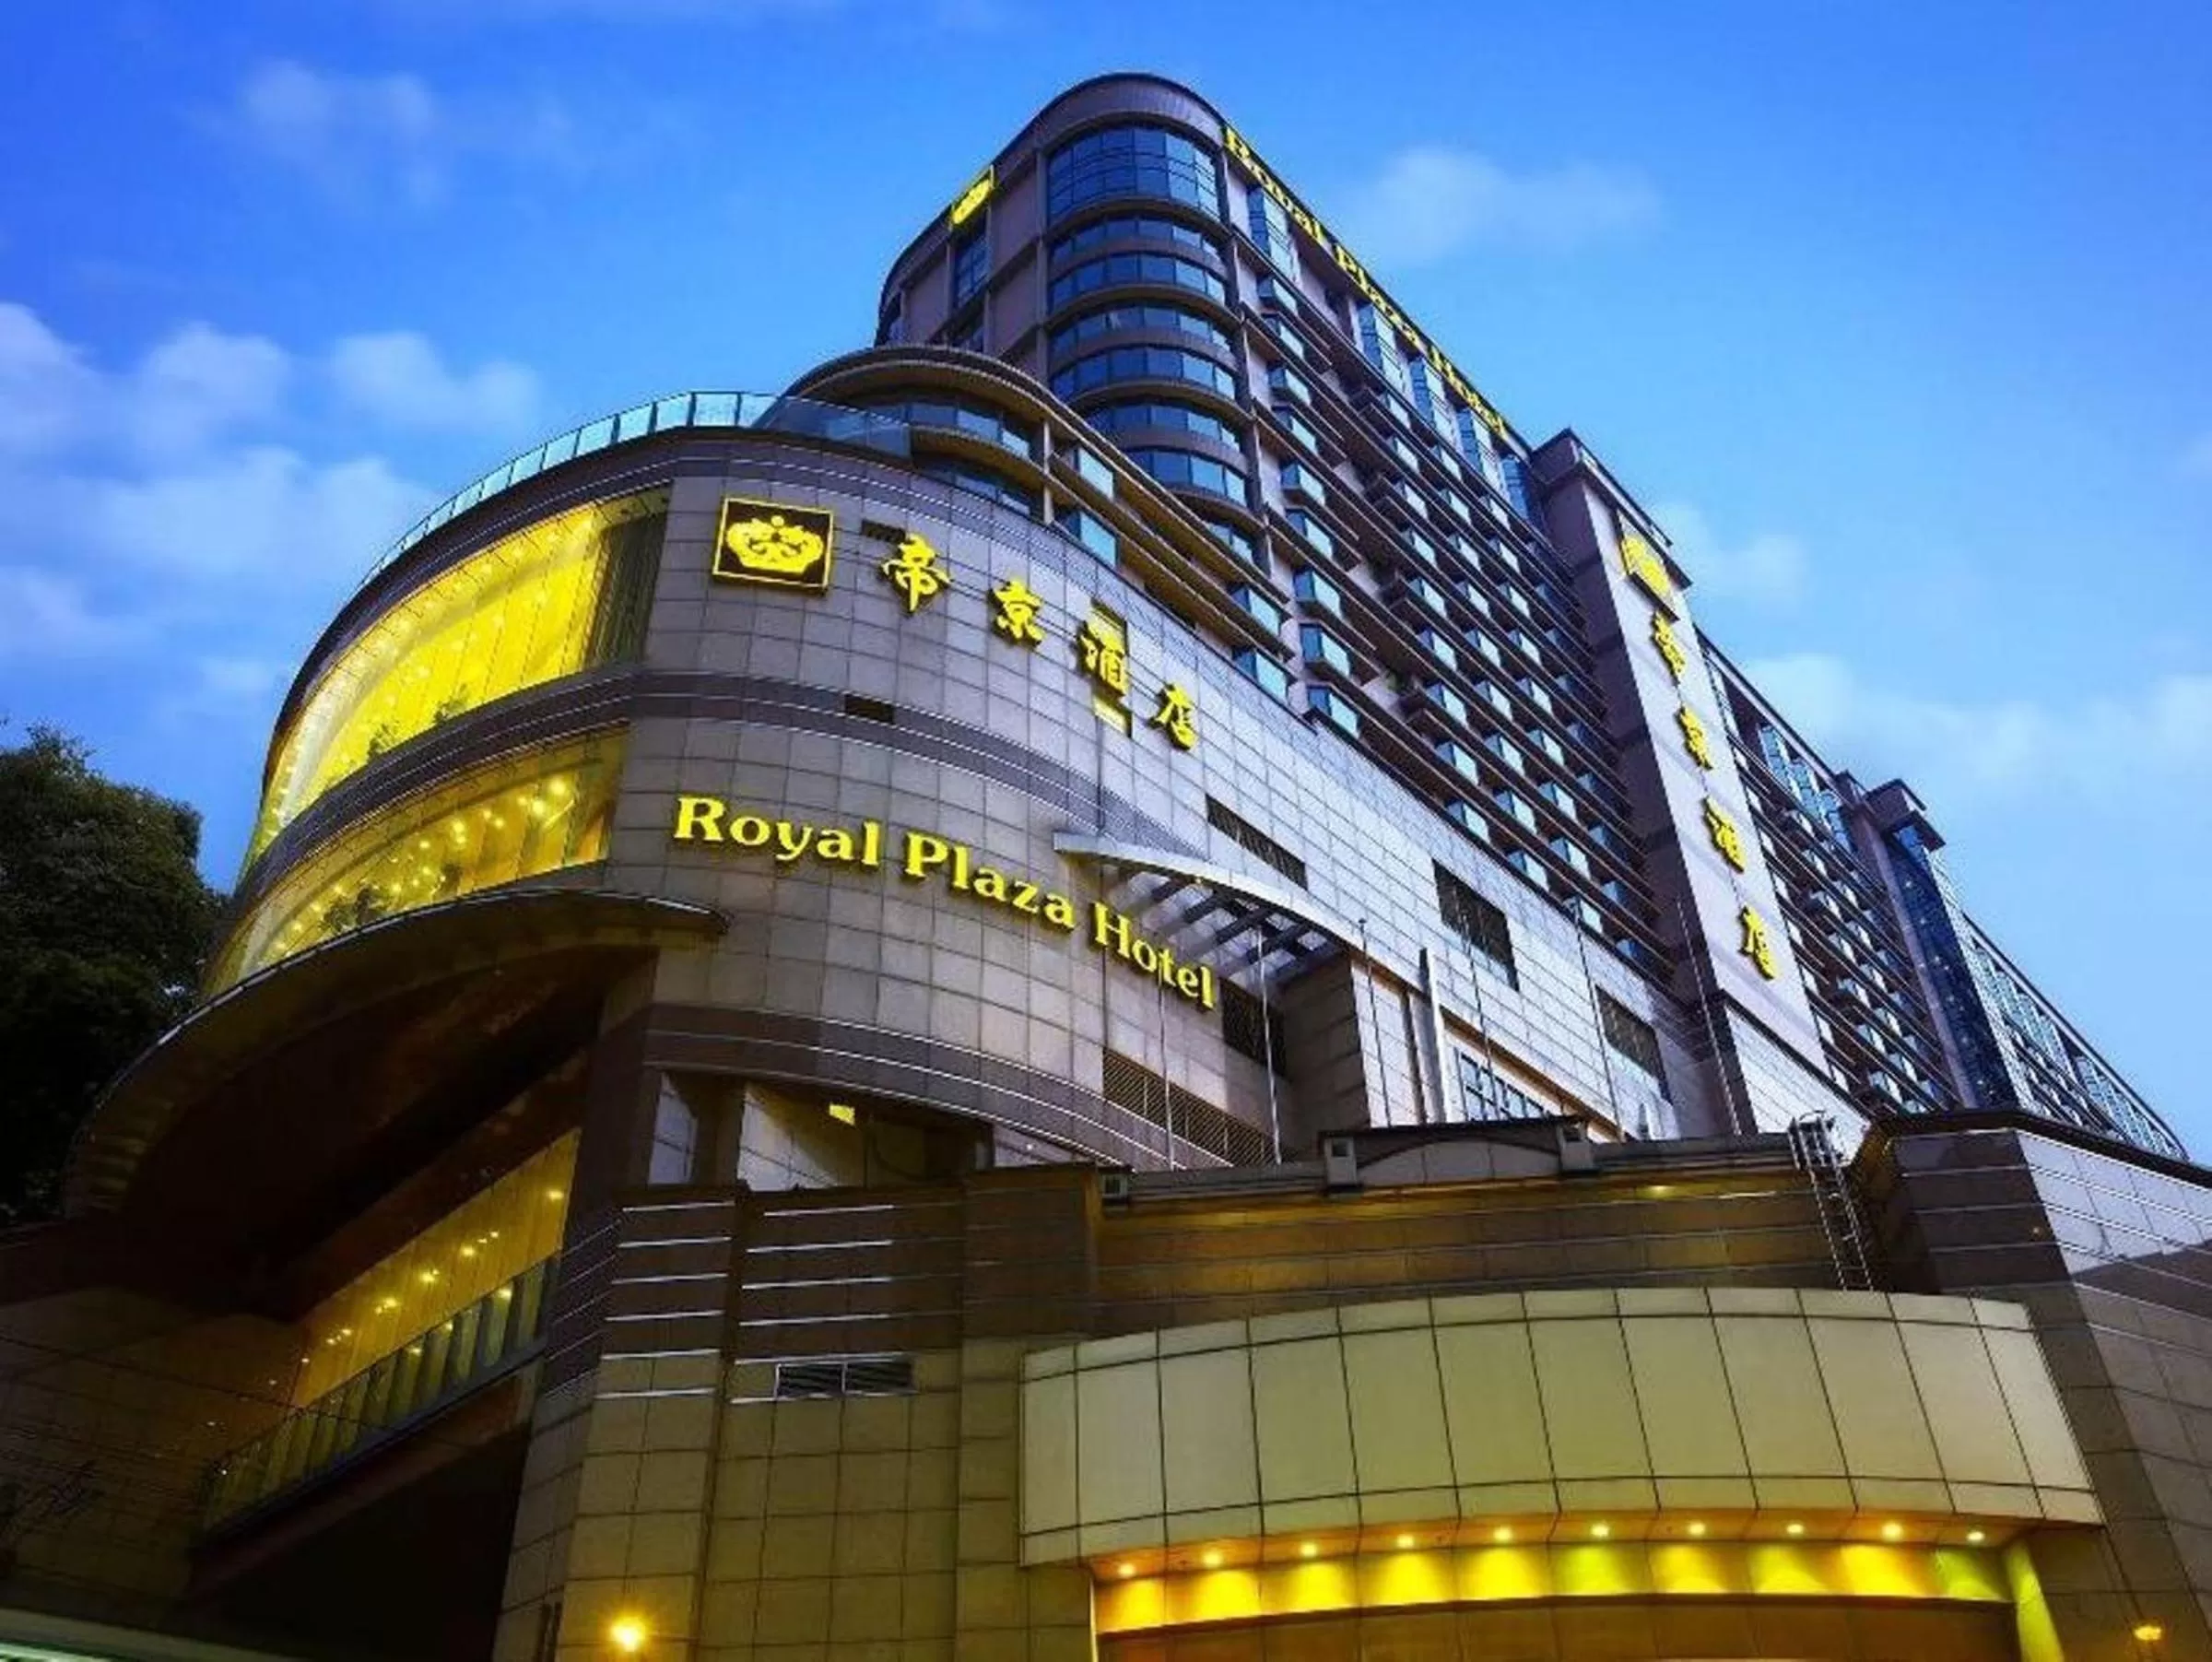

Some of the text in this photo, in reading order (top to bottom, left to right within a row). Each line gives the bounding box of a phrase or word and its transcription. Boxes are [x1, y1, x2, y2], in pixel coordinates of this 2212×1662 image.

[881, 533, 1200, 750] 帝京酒店
[674, 795, 1216, 1009] Royal Plaza Hotel
